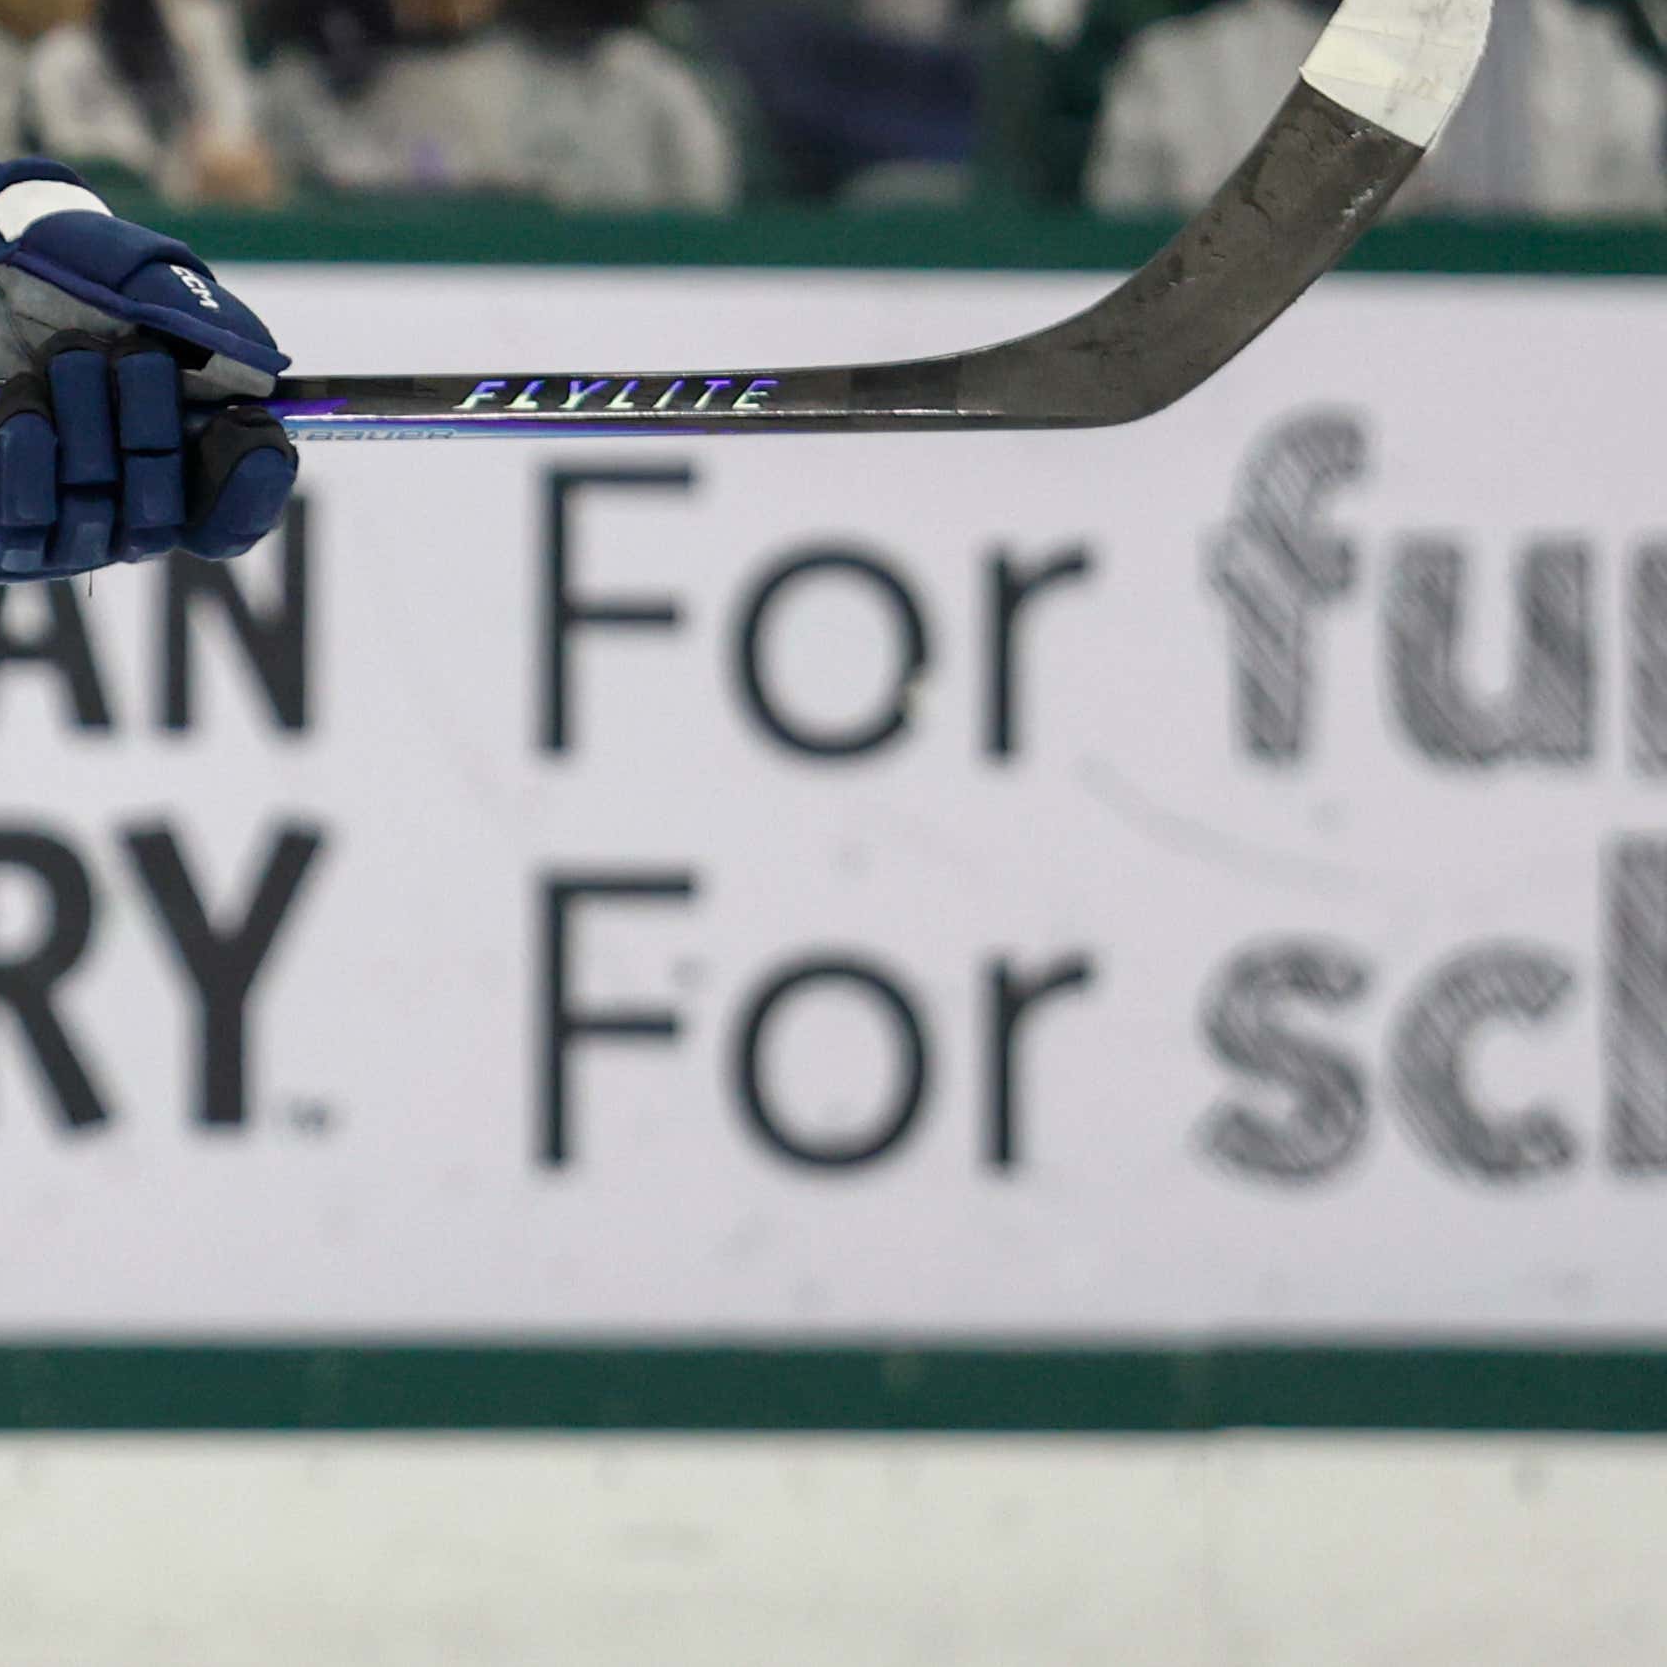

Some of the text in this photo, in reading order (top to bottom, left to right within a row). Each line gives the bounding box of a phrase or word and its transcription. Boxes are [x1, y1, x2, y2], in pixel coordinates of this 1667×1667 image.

[169, 263, 219, 309] CCM
[453, 379, 779, 411] FLYLITE
[535, 399, 1667, 770] For fu
[535, 872, 1095, 1176] For
